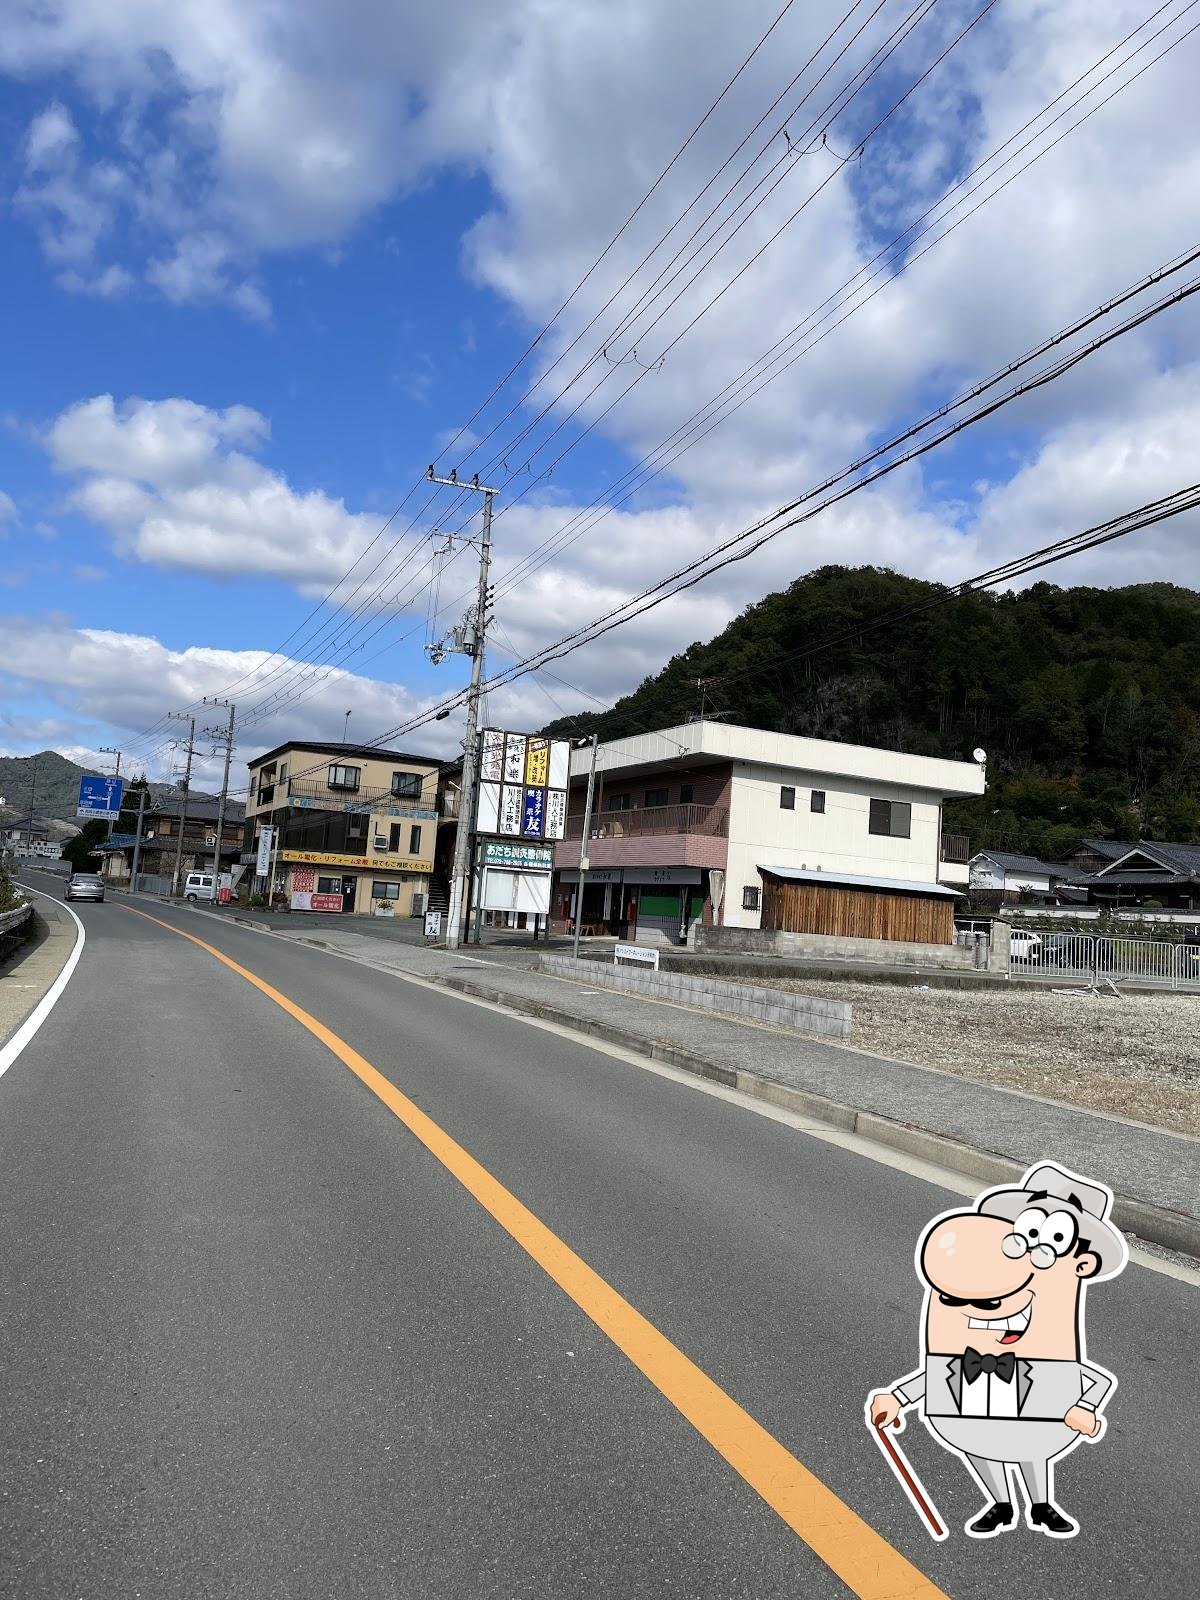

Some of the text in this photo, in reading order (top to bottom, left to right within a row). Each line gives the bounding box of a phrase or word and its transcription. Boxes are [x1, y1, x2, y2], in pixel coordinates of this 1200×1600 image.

[538, 751, 546, 784] リフォーム
[534, 790, 543, 817] カラオケ
[525, 816, 541, 832] 友
